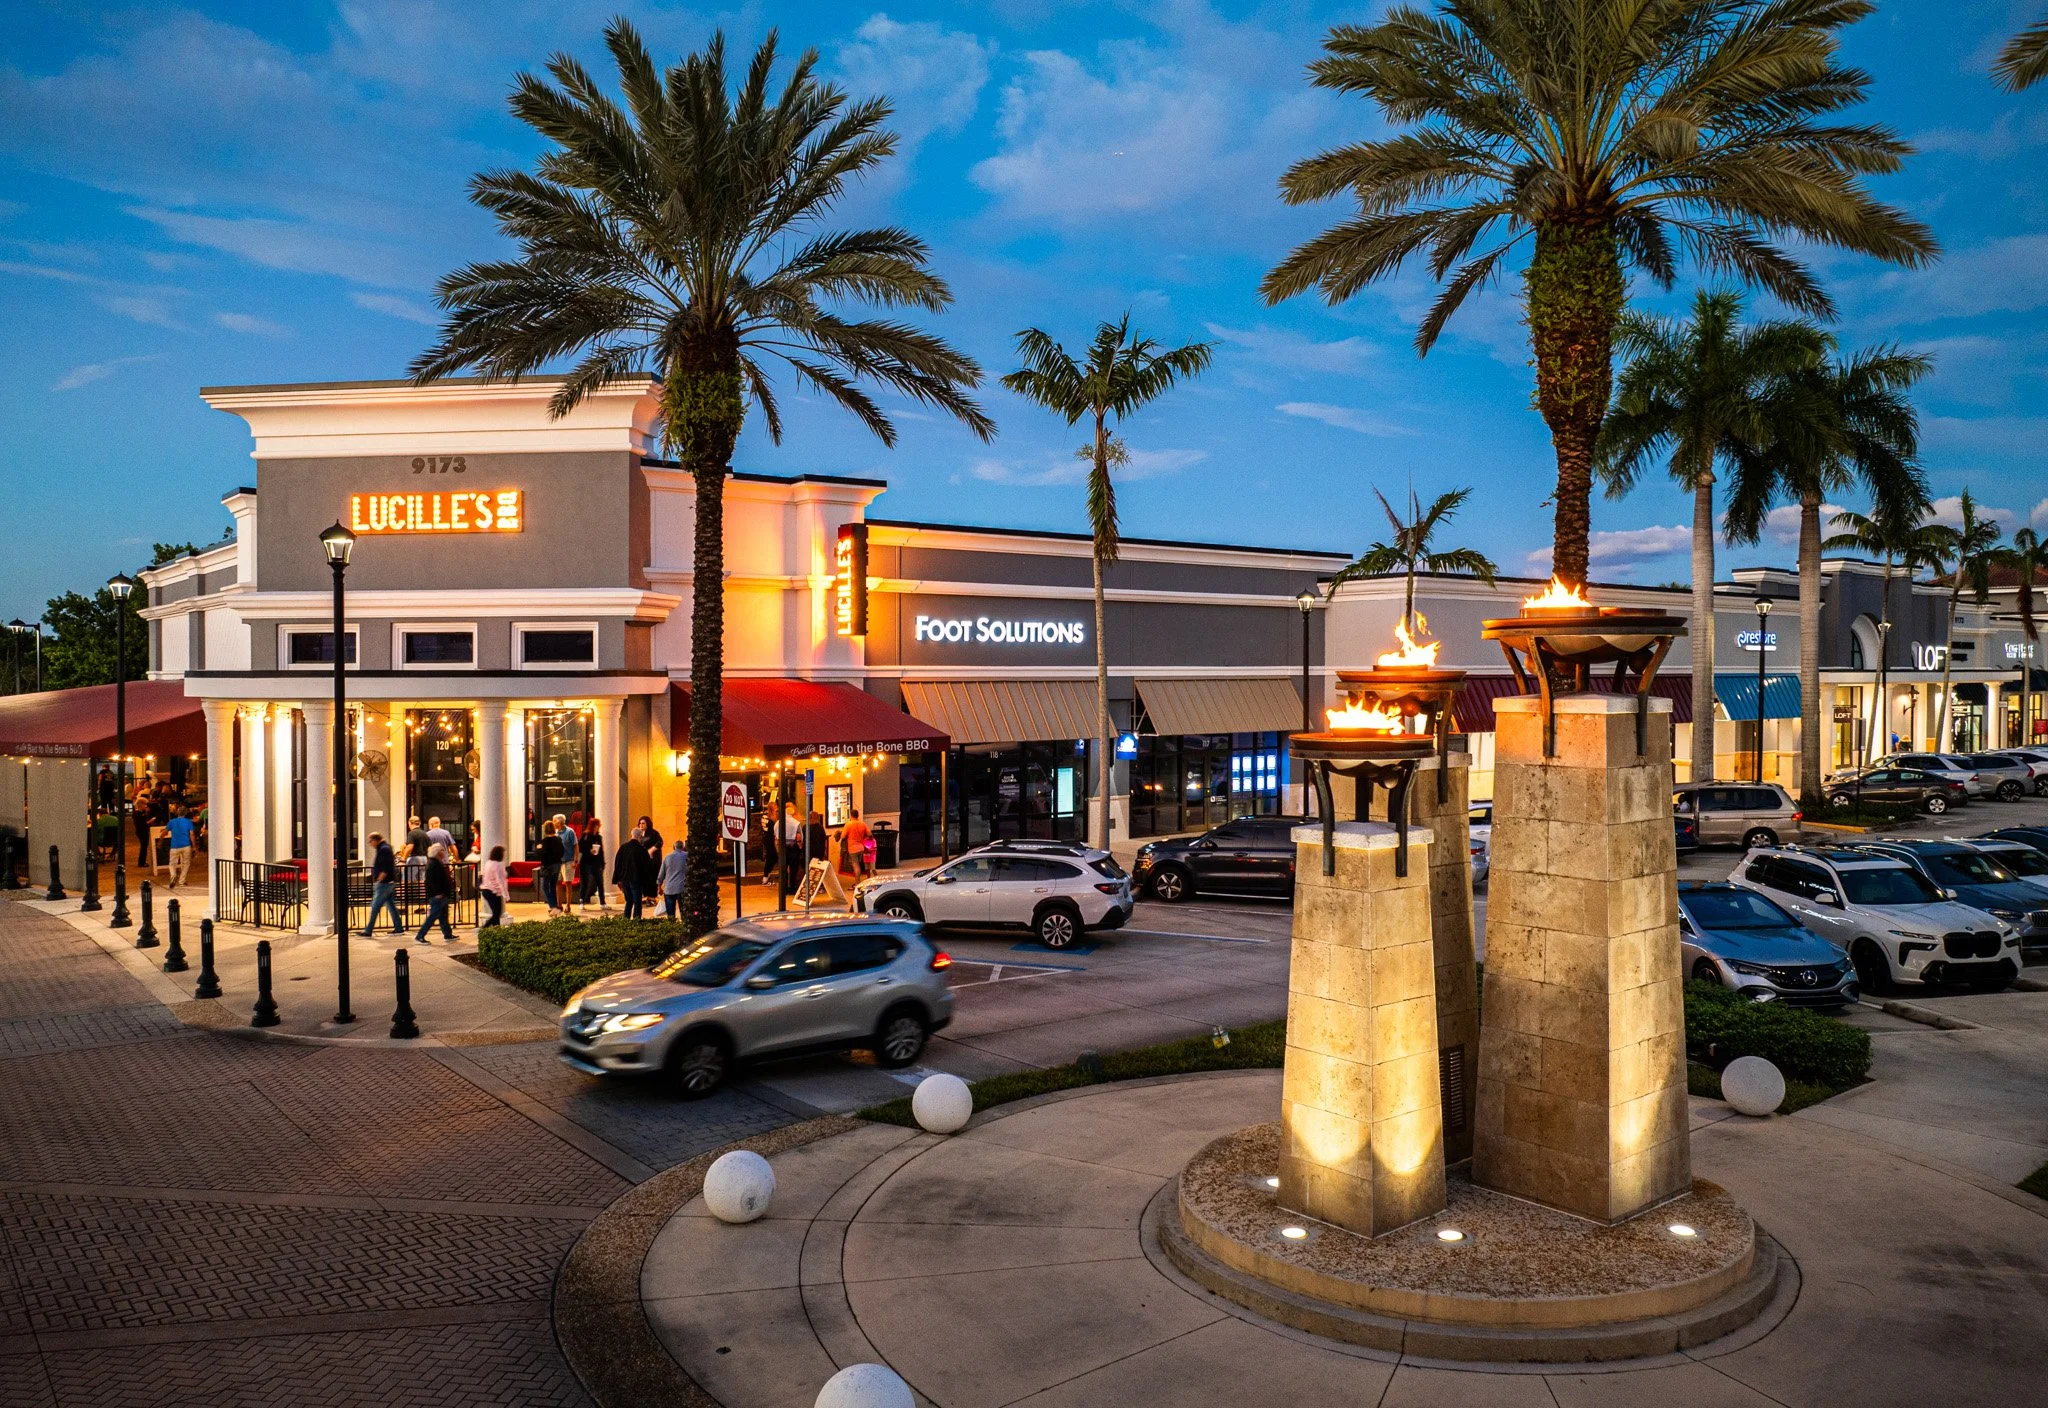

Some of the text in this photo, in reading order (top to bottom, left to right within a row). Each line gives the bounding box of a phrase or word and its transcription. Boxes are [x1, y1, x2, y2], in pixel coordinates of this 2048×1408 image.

[411, 456, 467, 475] 9173
[352, 492, 493, 531] LUCILLE'S
[915, 615, 1084, 643] FOOT SOLUTIONS
[436, 740, 450, 750] 120
[819, 744, 840, 755] Bad
[843, 744, 854, 754] to
[857, 742, 873, 753] the
[876, 741, 903, 752] Bone
[906, 740, 929, 751] BBQ
[725, 793, 744, 806] DO NOT
[726, 818, 744, 831] ENTER
